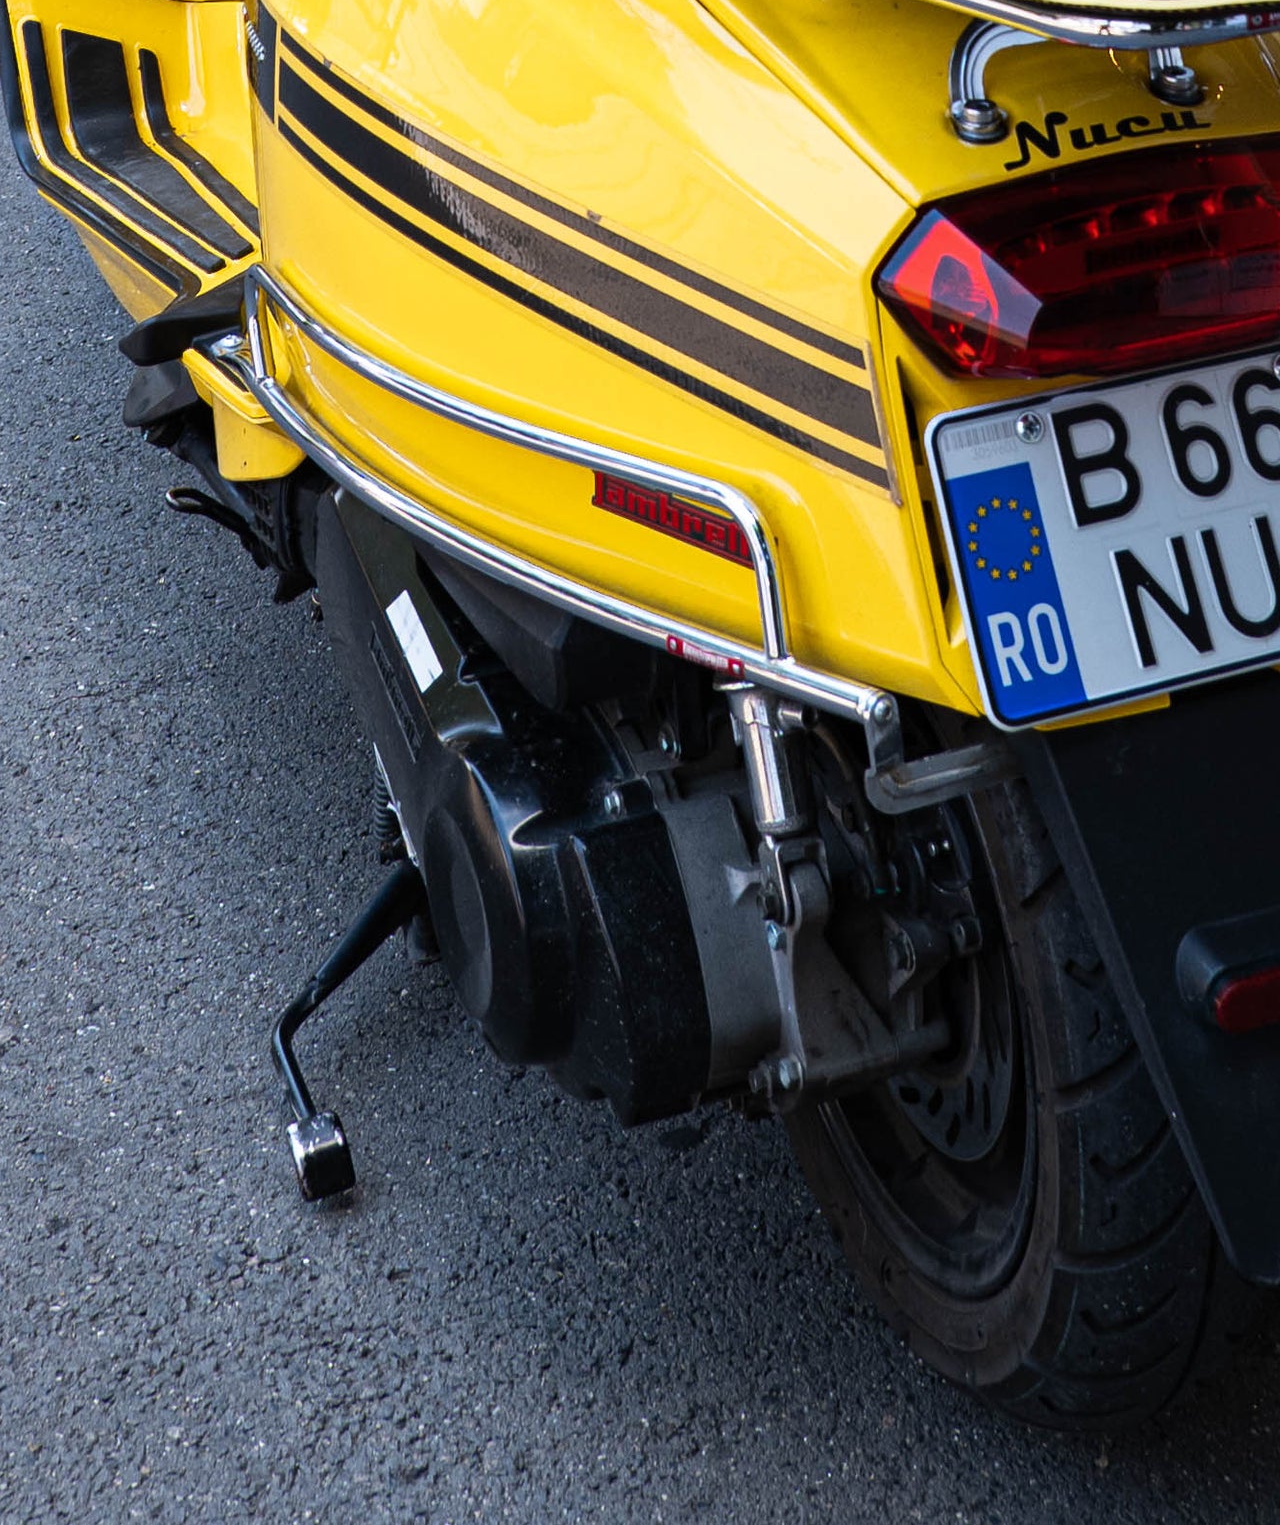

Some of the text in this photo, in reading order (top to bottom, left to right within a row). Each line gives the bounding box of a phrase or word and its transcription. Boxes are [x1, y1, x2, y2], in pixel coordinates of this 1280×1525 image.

[1003, 110, 1212, 172] Nucu
[1050, 402, 1142, 529] B
[987, 601, 1070, 688] RO
